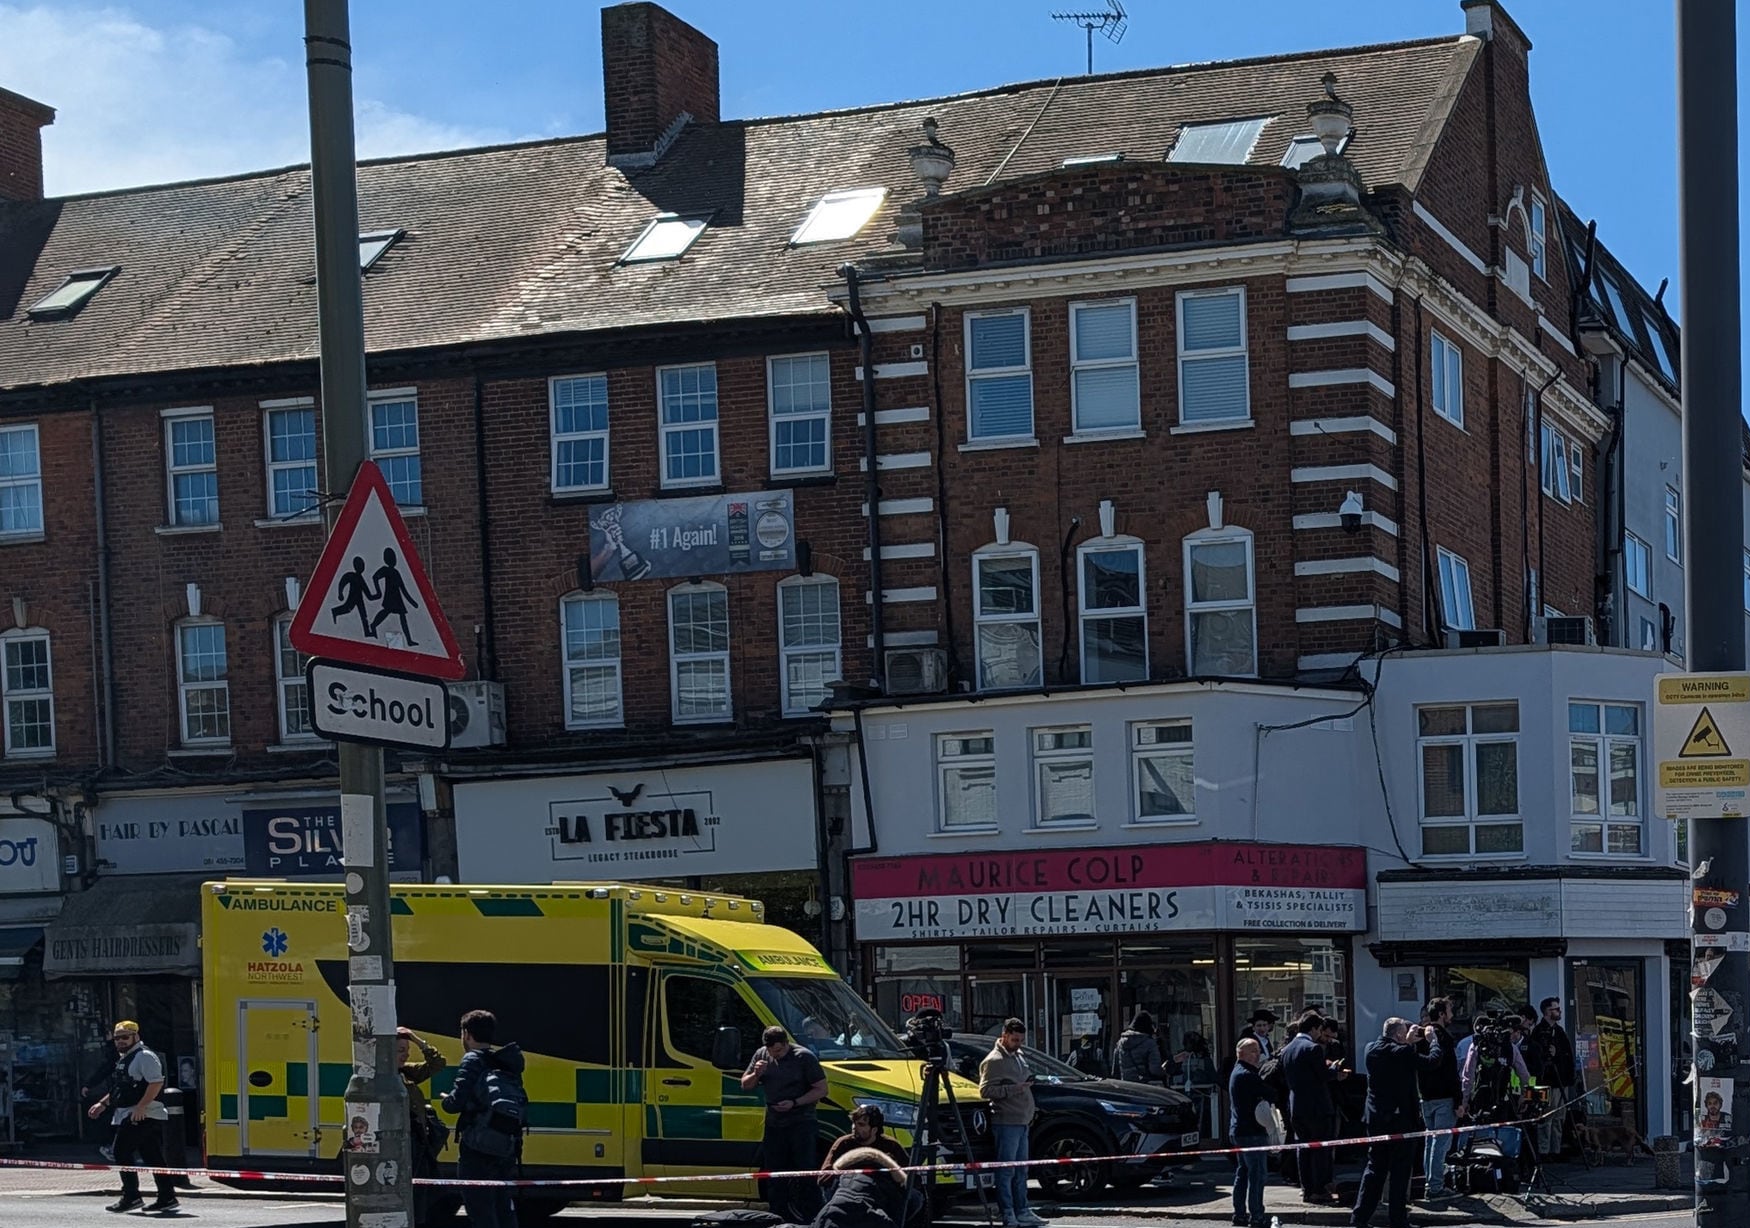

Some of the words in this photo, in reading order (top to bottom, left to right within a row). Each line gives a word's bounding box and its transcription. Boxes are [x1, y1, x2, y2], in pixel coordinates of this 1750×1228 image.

[650, 528, 668, 550] #1
[672, 523, 718, 551] Again!
[1681, 681, 1729, 691] WARNING
[327, 681, 434, 730] School
[304, 815, 335, 827] THE
[558, 815, 592, 844] LA
[604, 808, 700, 842] FIESTA
[100, 822, 141, 841] HAIR
[149, 821, 170, 839] BY
[179, 817, 242, 838] PASCAL
[588, 852, 620, 863] LEGACY
[623, 848, 679, 860] STEAKHOUSE
[918, 860, 1048, 891] MAURICE
[1067, 854, 1144, 884] COLP
[1244, 889, 1306, 900] BEKASHAS,
[1309, 891, 1345, 900] TALLIT
[232, 898, 337, 912] AMBULANCE
[891, 900, 941, 928] 2HR
[958, 897, 1011, 926] DRY
[1031, 891, 1179, 922] CLEANERS
[1236, 901, 1243, 910] &
[1247, 901, 1282, 910] TSISIS
[1286, 902, 1354, 912] SPECIALISTS
[912, 928, 954, 938] SHIRTS
[972, 927, 1016, 936] TAILOR
[1024, 925, 1076, 935] REPAIRS
[1095, 922, 1159, 932] CURTAINS
[1243, 919, 1261, 927] FREE
[1262, 919, 1306, 928] COLLECTION
[1314, 920, 1347, 928] DELIVERY
[52, 939, 89, 960] GENTS
[92, 935, 182, 959] HAIRDRESSERS
[248, 962, 304, 973] HATZOLA
[248, 972, 304, 982] NORTHWEST
[902, 994, 944, 1014] OPEN
